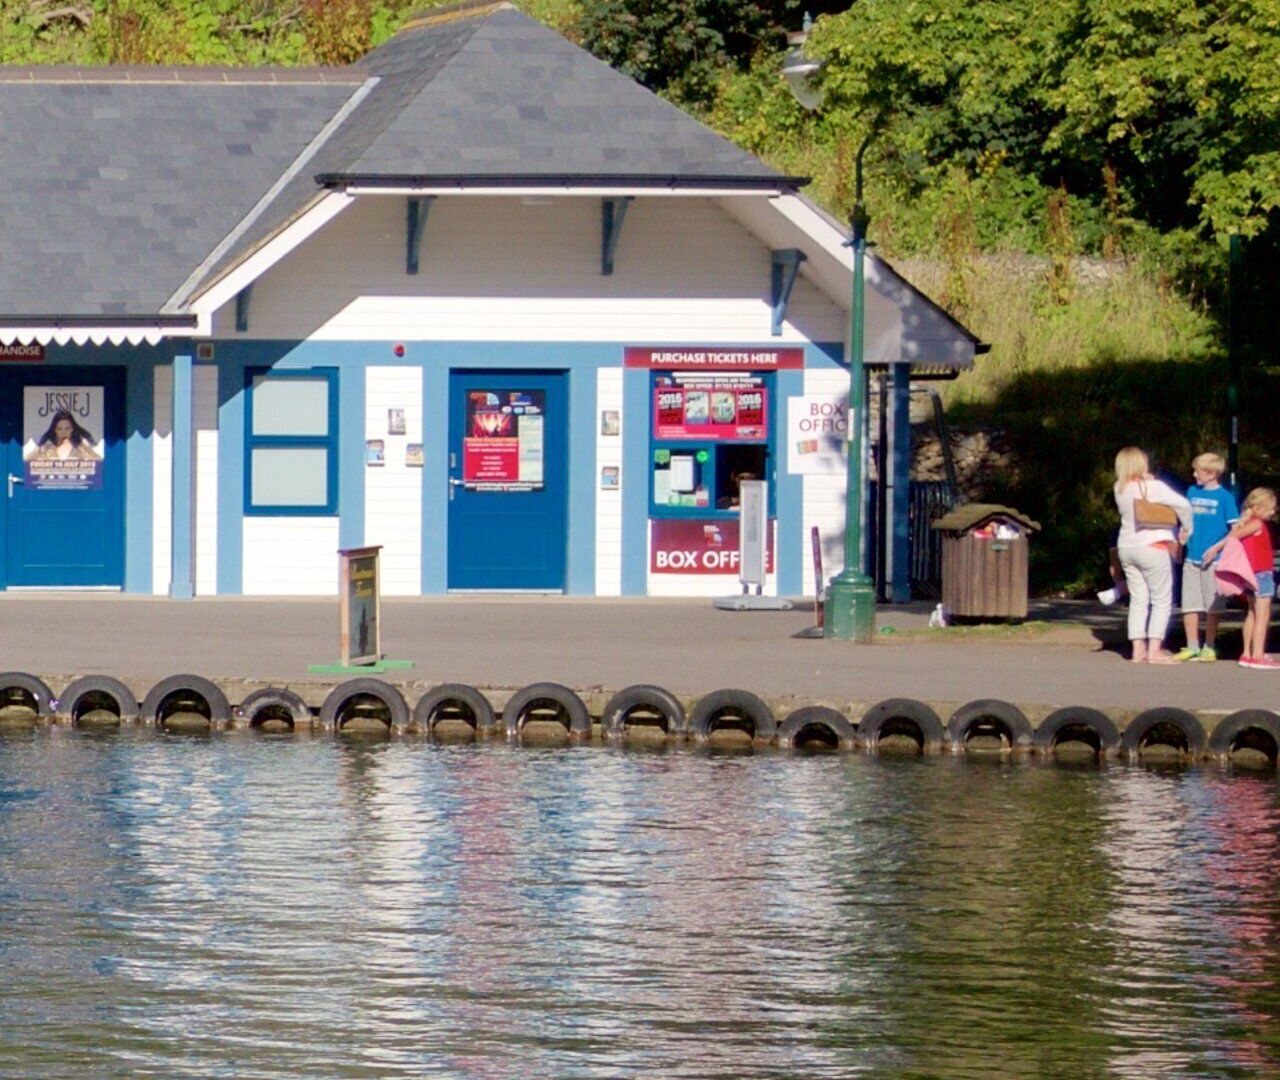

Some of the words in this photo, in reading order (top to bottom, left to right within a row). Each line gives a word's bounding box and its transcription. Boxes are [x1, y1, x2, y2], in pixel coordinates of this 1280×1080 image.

[651, 352, 705, 363] PURCHASE
[707, 352, 749, 364] TICKETS
[751, 352, 778, 364] HERE
[38, 392, 79, 417] JESSIE
[79, 392, 90, 417] J
[810, 403, 844, 416] BOX
[799, 419, 848, 432] OFFIC
[656, 551, 698, 568] BOX
[702, 551, 769, 568] OFF
